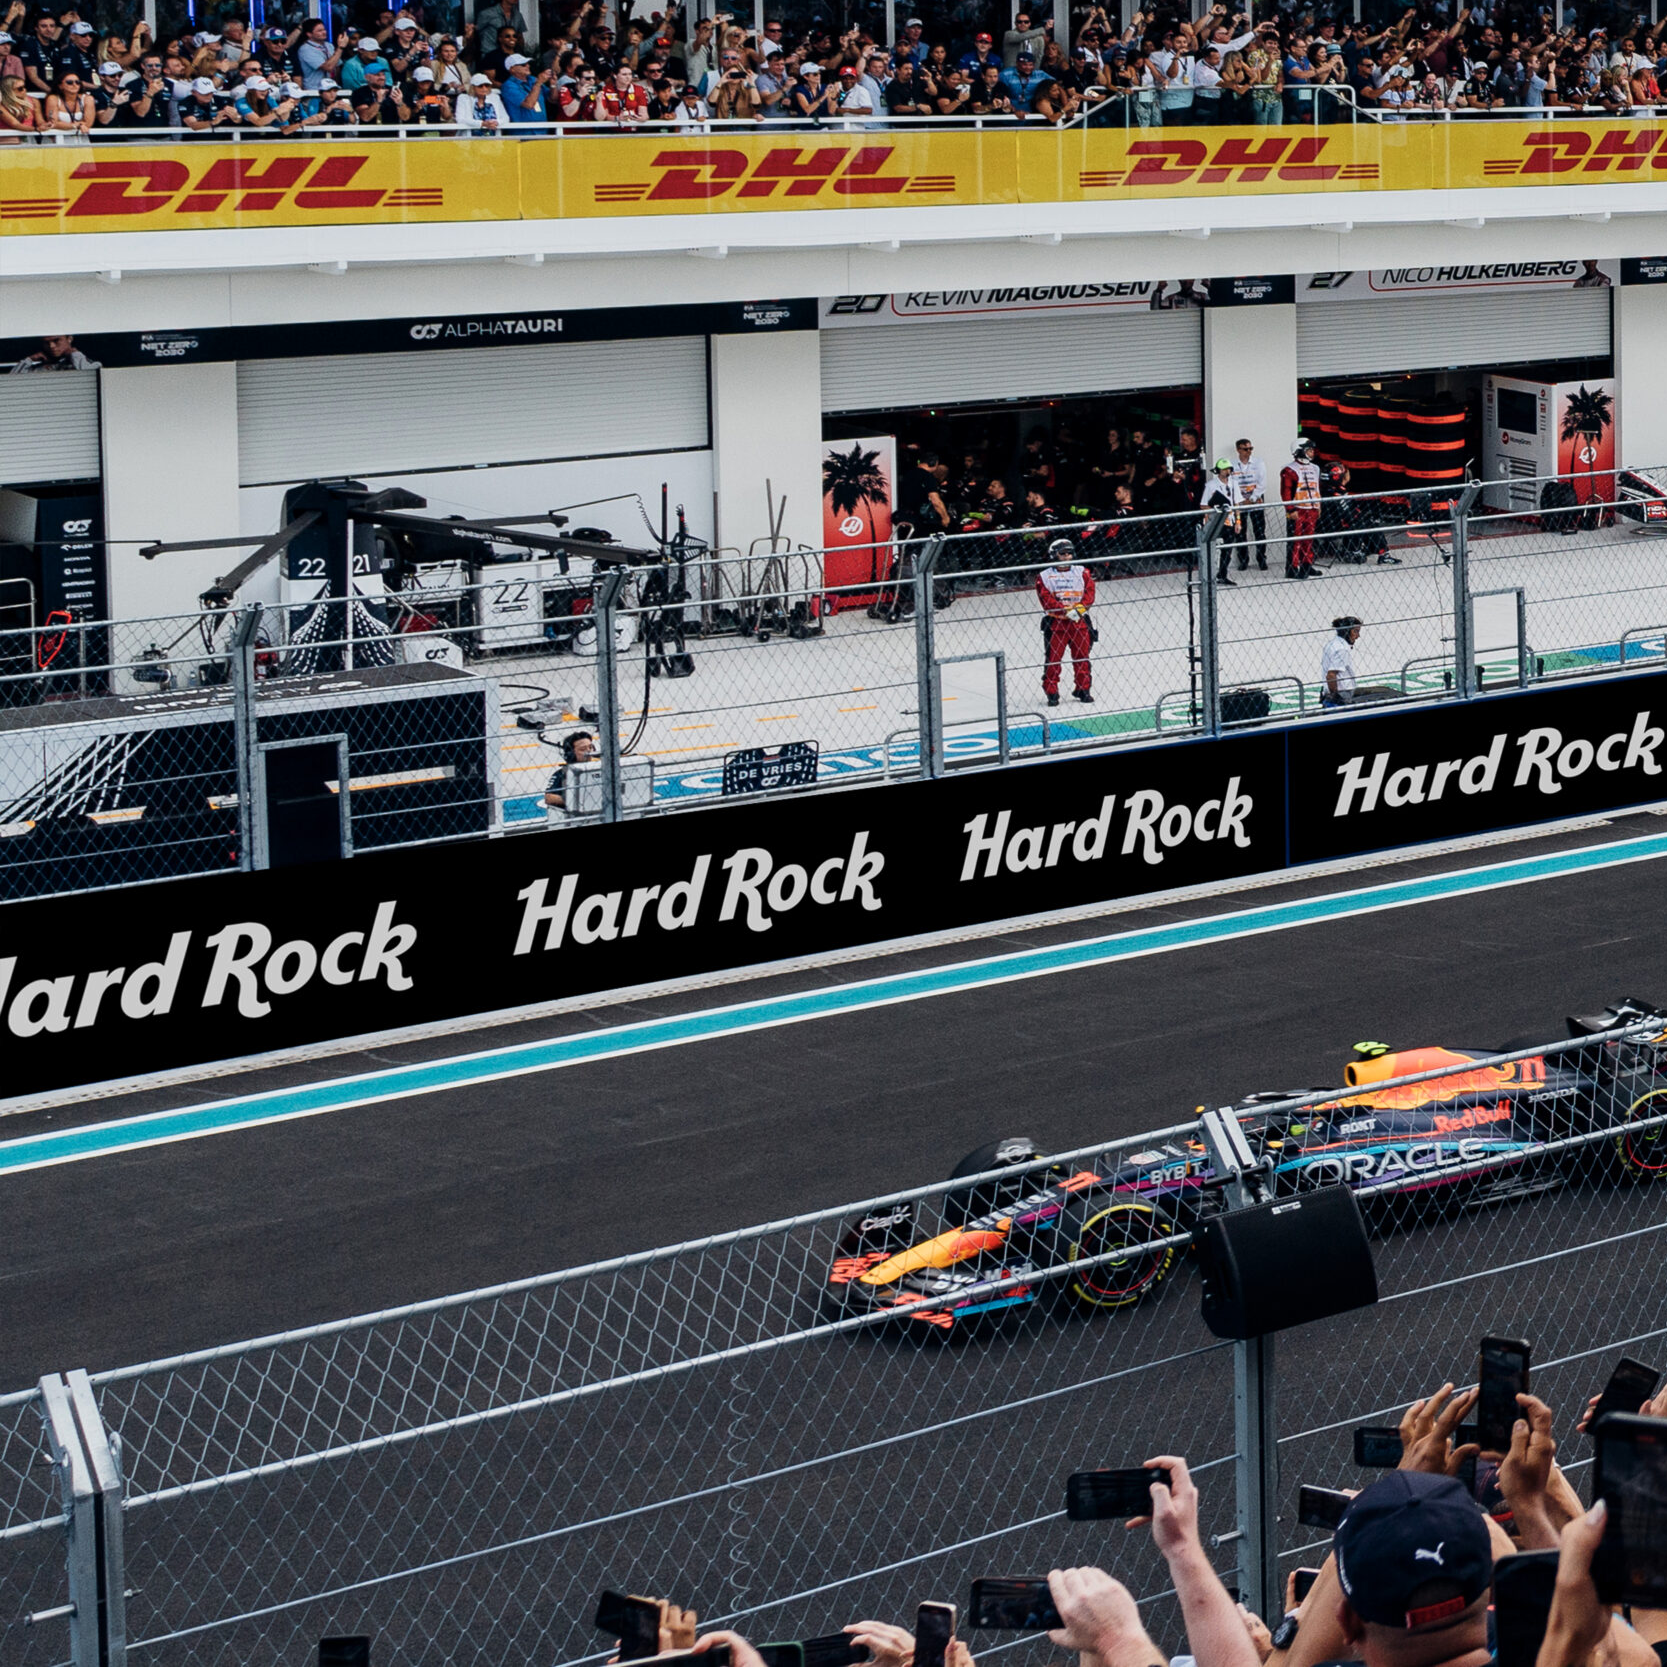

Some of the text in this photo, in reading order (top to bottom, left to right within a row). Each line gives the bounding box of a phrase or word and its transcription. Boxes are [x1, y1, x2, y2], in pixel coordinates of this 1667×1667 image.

[1125, 138, 1339, 184] DHL
[647, 148, 908, 201] DHL
[65, 156, 386, 217] DHL
[1306, 271, 1354, 290] 27
[1382, 260, 1578, 284] NICO HULKENBERG
[904, 280, 1151, 308] KEVIN MAGNUSSEN
[1252, 285, 1272, 293] ZERO
[743, 309, 790, 319] NET ZERO
[828, 294, 888, 316] 20
[444, 317, 565, 337] ALPHATAURI
[755, 317, 780, 325] 2030
[141, 339, 199, 352] NET ZERO
[155, 348, 186, 357] 2030
[298, 558, 326, 576] 22
[353, 554, 371, 574] 21
[493, 579, 530, 605] 22
[739, 762, 803, 780] DE VRIES
[1334, 711, 1664, 816] Hard Rock
[960, 776, 1252, 881] Hard Rock
[514, 831, 884, 955] Hard Rock
[0, 901, 417, 1038] ard Rock
[1528, 1087, 1579, 1105] HONDA
[1340, 1118, 1377, 1135] ROKT
[1435, 1099, 1511, 1133] Red Bull
[1304, 1137, 1489, 1183] ORACLE
[1150, 1162, 1201, 1185] BYBIT
[860, 1206, 910, 1232] Claro
